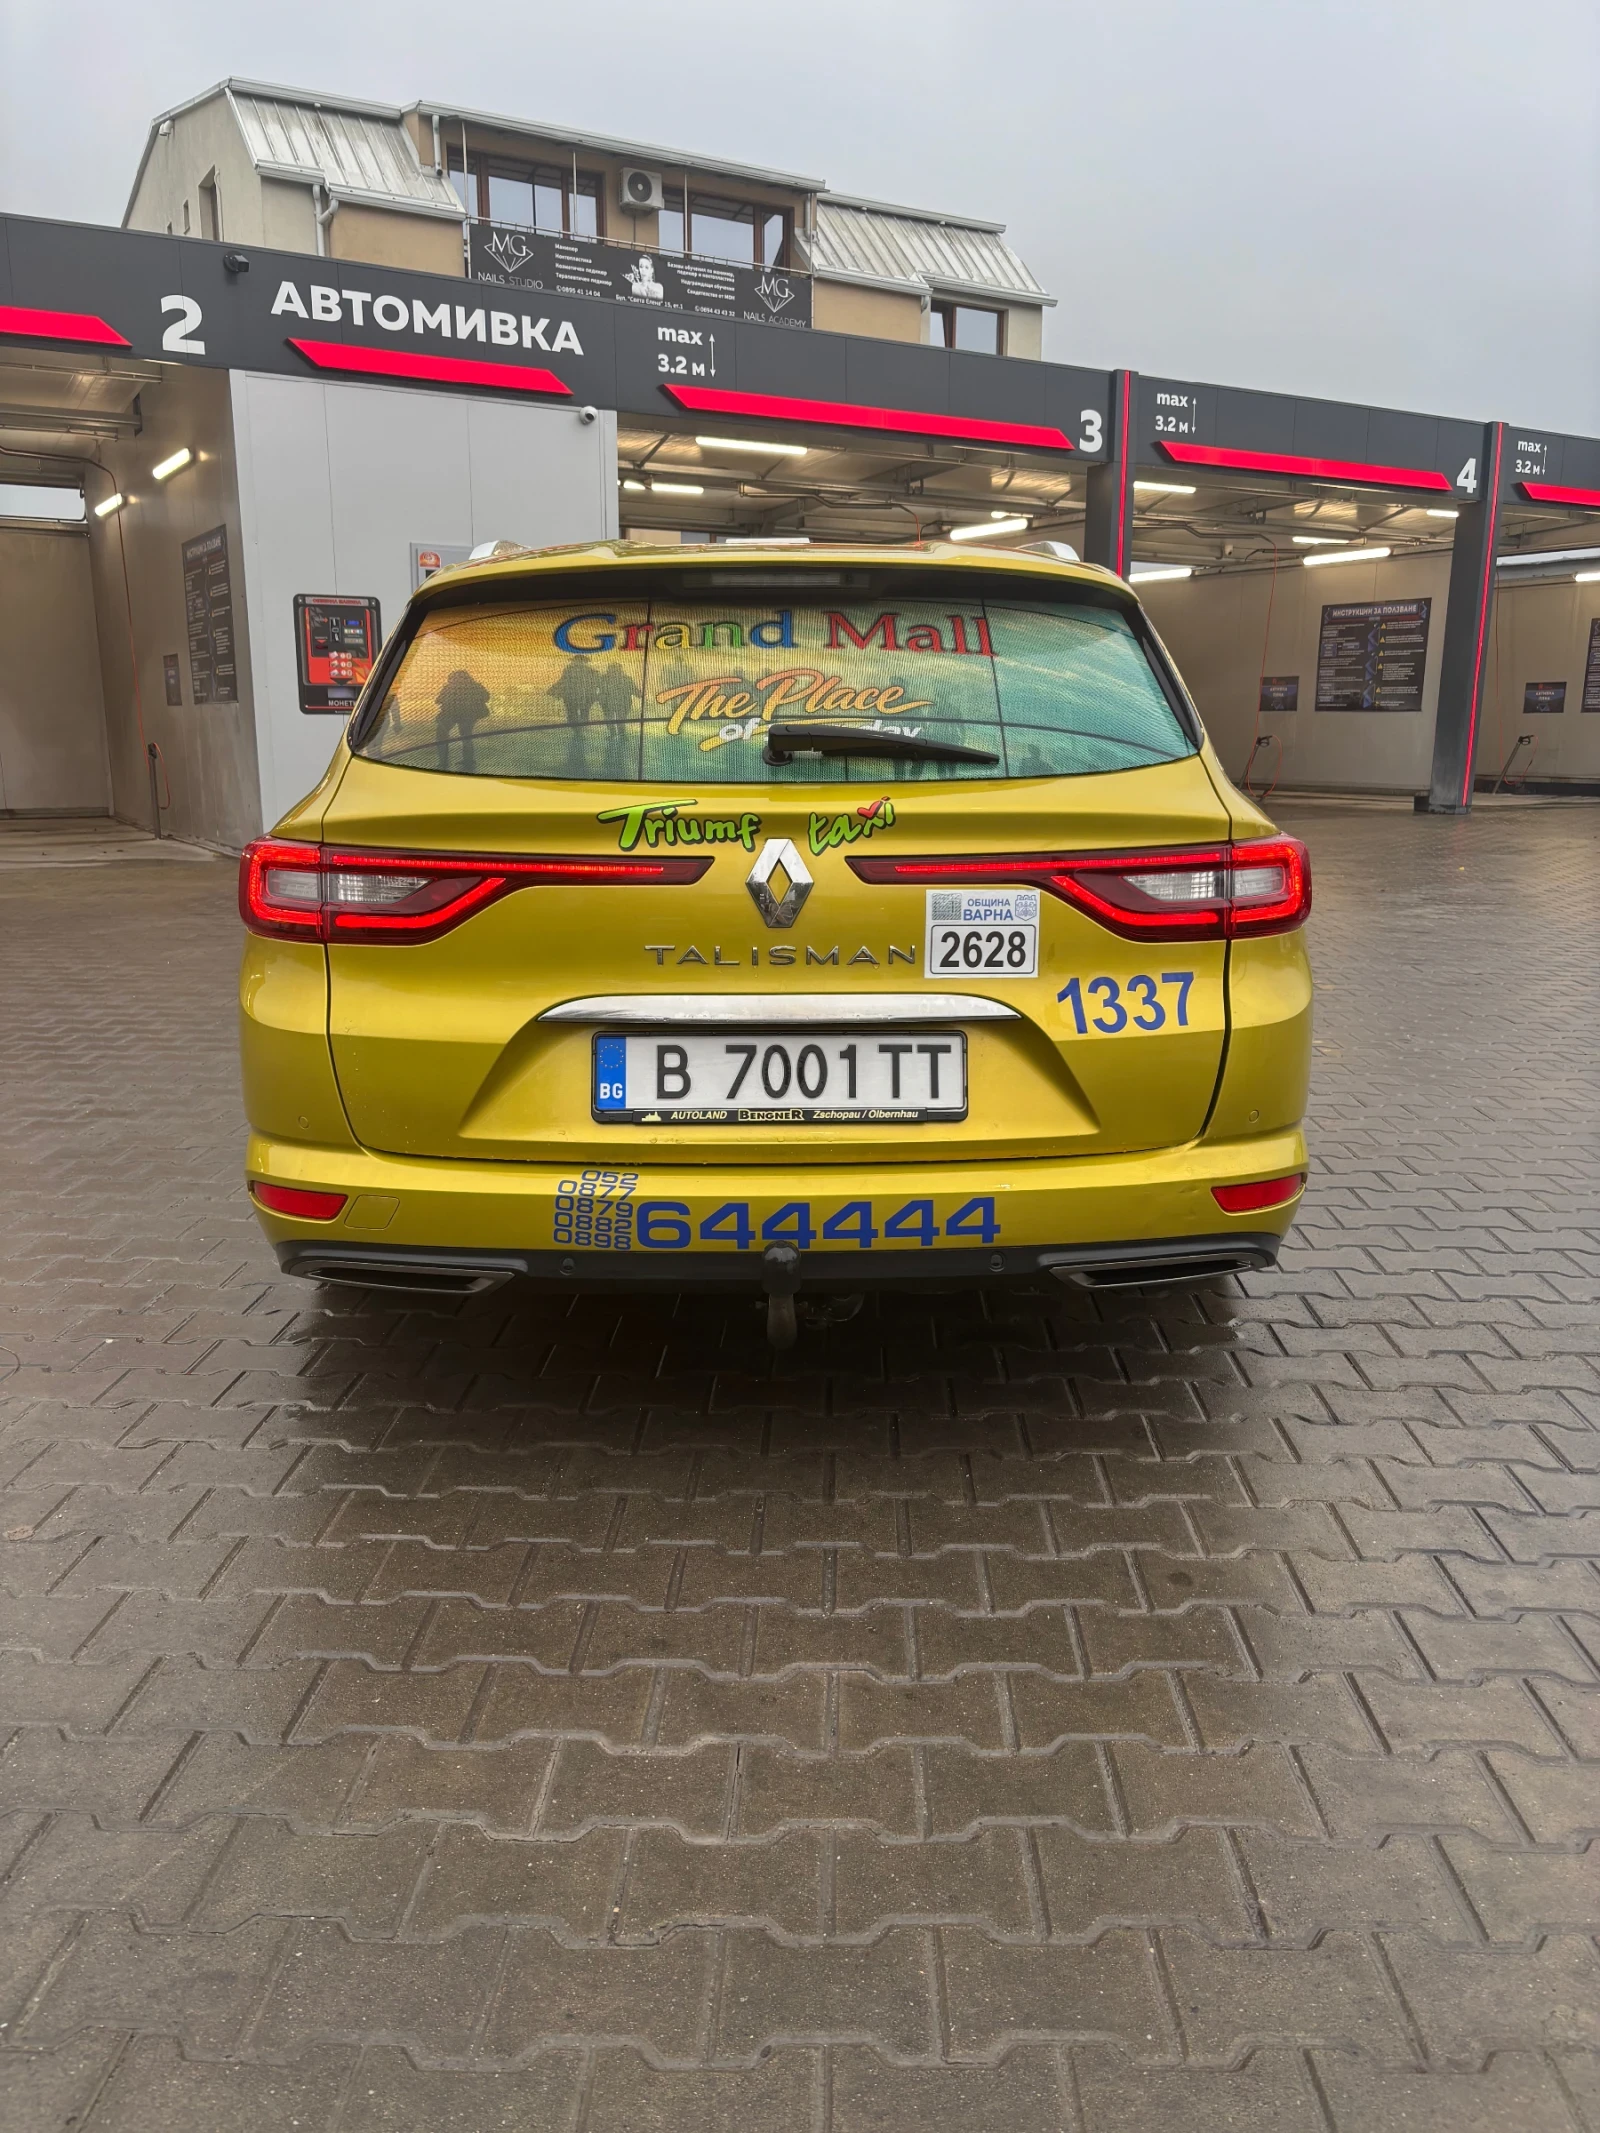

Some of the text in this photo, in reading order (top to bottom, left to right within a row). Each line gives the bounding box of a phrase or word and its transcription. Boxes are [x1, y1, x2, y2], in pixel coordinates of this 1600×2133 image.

[492, 231, 526, 256] MG
[478, 272, 544, 290] NAILS STUDIO
[760, 275, 789, 298] MG
[161, 294, 206, 356] 2
[270, 280, 584, 356] АВТОМИВКА
[744, 311, 806, 328] NAILS ACADEMY
[658, 326, 703, 346] max
[658, 353, 687, 374] 3.2
[1156, 392, 1188, 407] max
[1079, 409, 1103, 453] 3
[1155, 415, 1176, 432] 3.2
[1517, 440, 1541, 453] max
[1456, 457, 1477, 494] 4
[1515, 459, 1531, 474] 3.2
[1332, 607, 1372, 617] ИНСТРУКЦИИ
[1383, 605, 1417, 614] ПОЛЗВАНЕ
[554, 610, 998, 658] Grand Mall
[656, 668, 934, 736] The Place
[719, 717, 762, 741] of
[597, 796, 896, 856] Triumf taxi
[967, 898, 1011, 908] ОБЩИНА
[963, 910, 1014, 921] ВАРНА
[644, 945, 916, 966] TALISMAN
[939, 930, 1026, 968] 2628
[1056, 971, 1194, 1034] 1337
[600, 1082, 624, 1099] BG
[670, 1110, 727, 1120] AUTOLAND
[812, 1110, 862, 1120] Zschopau
[868, 1109, 919, 1119] Olbernhau
[582, 1170, 639, 1186] 052
[558, 1180, 636, 1200] 0877
[555, 1194, 633, 1218] 0879
[554, 1212, 632, 1235] 0882
[636, 1196, 1001, 1250] 644444
[553, 1228, 631, 1250] 0898
